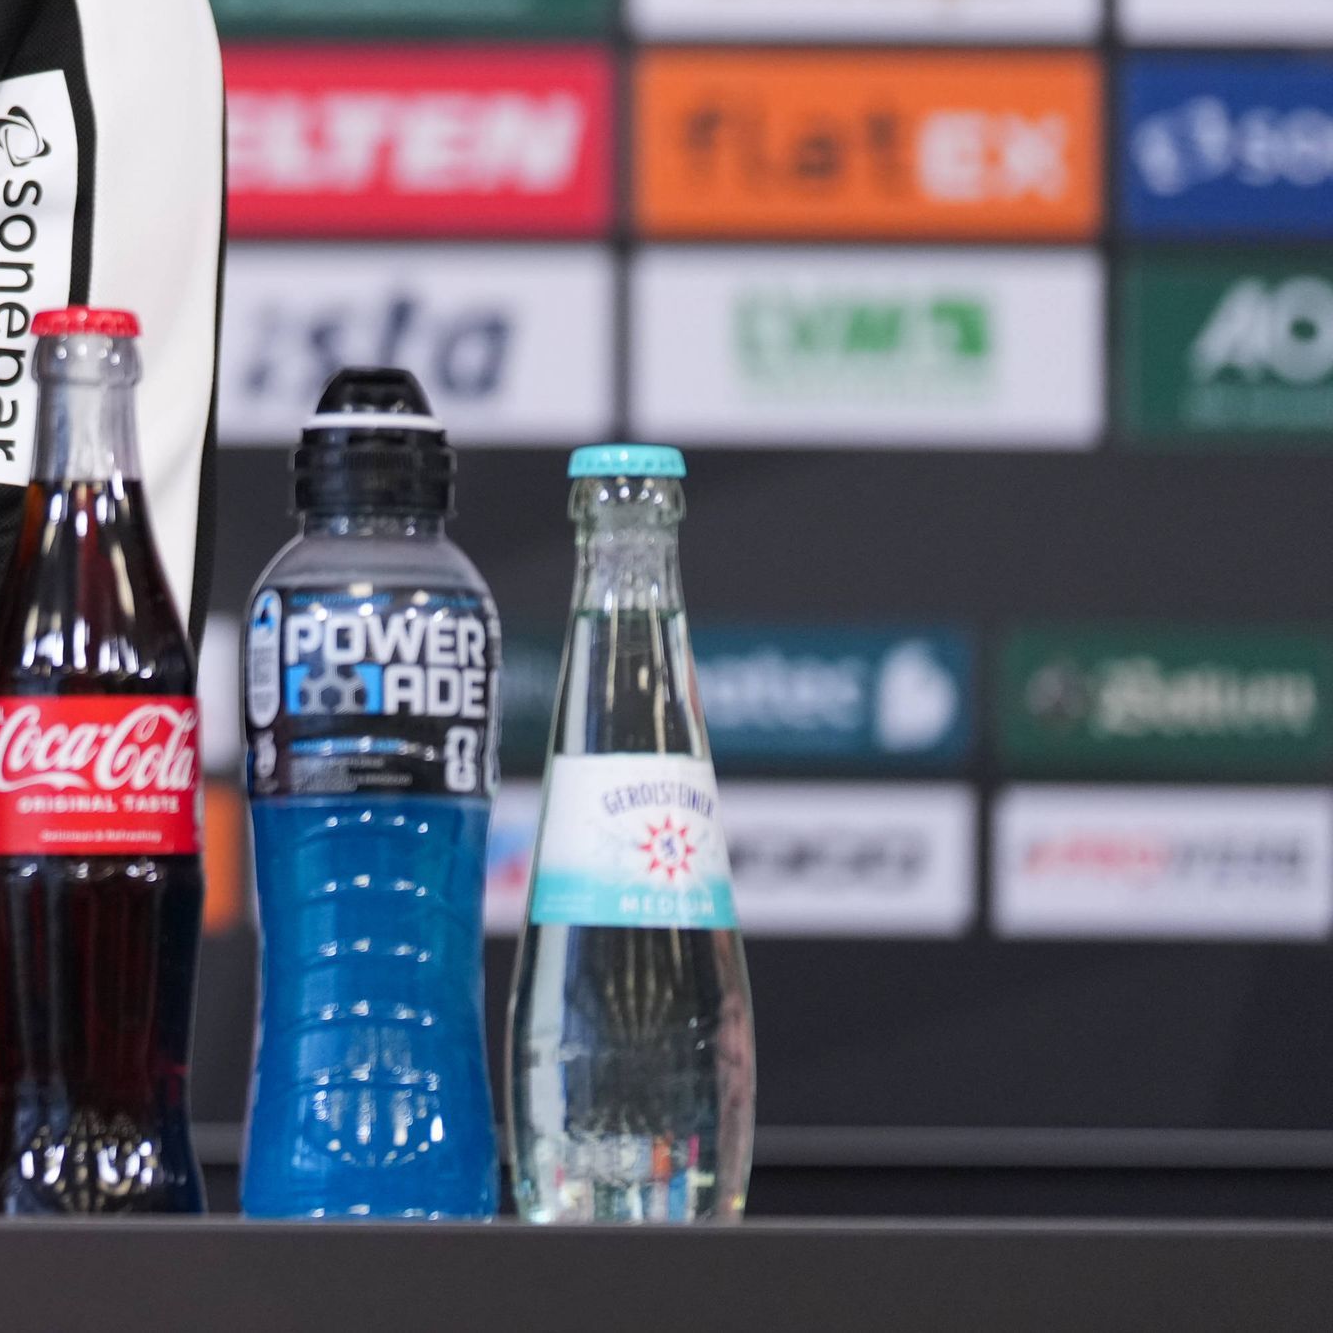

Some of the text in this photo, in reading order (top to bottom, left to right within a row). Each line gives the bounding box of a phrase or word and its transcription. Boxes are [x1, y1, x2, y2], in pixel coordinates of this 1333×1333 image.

[1187, 275, 1333, 388] AO
[285, 613, 486, 668] POWER
[382, 663, 486, 719] ADE
[16, 795, 180, 814] ORIGINAL TASTE
[601, 780, 715, 819] GEROLSTEINER
